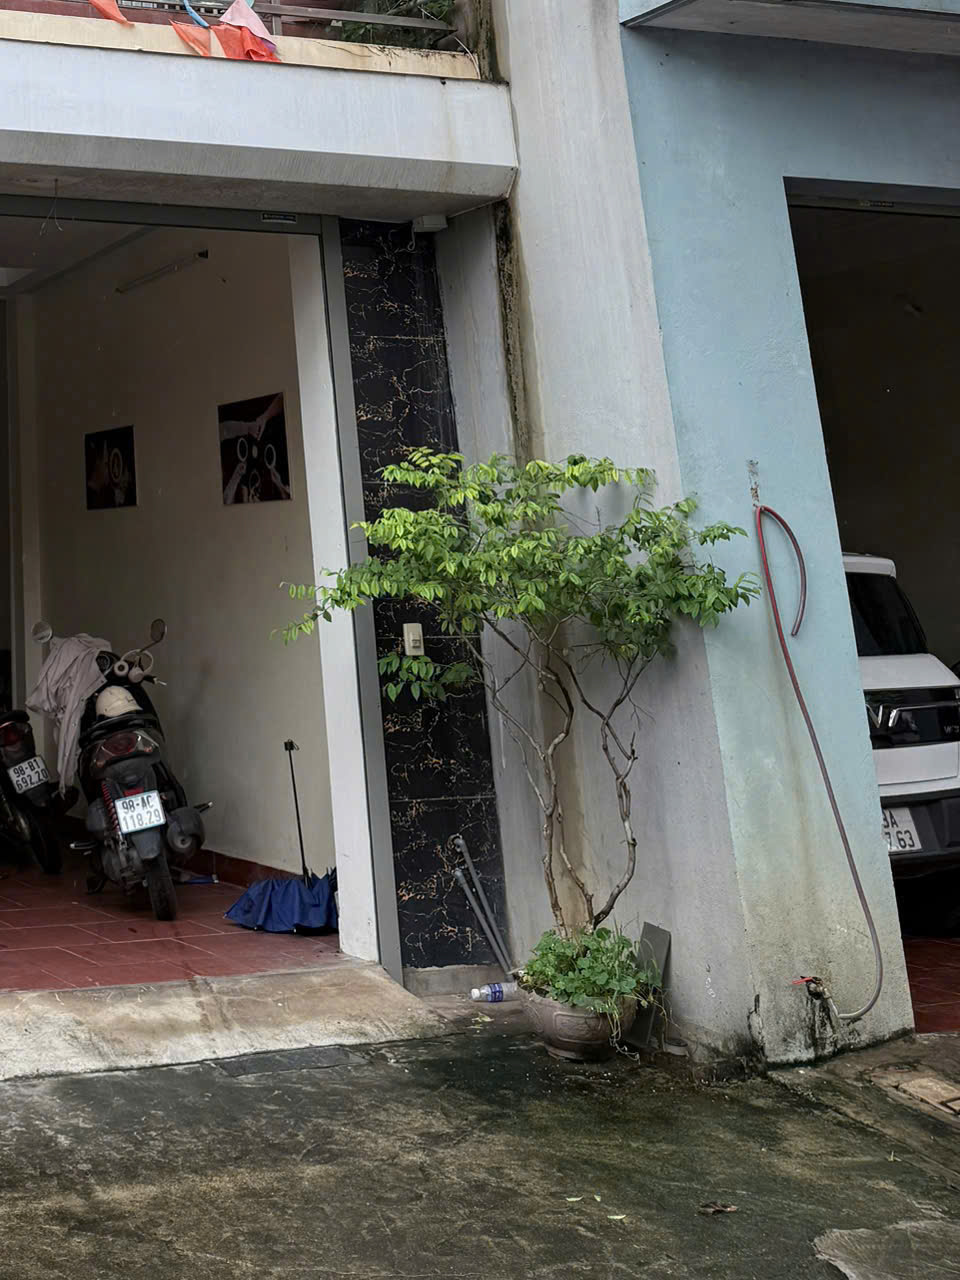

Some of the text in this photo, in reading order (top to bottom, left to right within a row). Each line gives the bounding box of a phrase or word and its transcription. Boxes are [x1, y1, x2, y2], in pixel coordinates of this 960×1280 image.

[13, 759, 41, 778] 98-B1
[122, 795, 153, 814] 98-AC
[123, 809, 161, 829] 118.29
